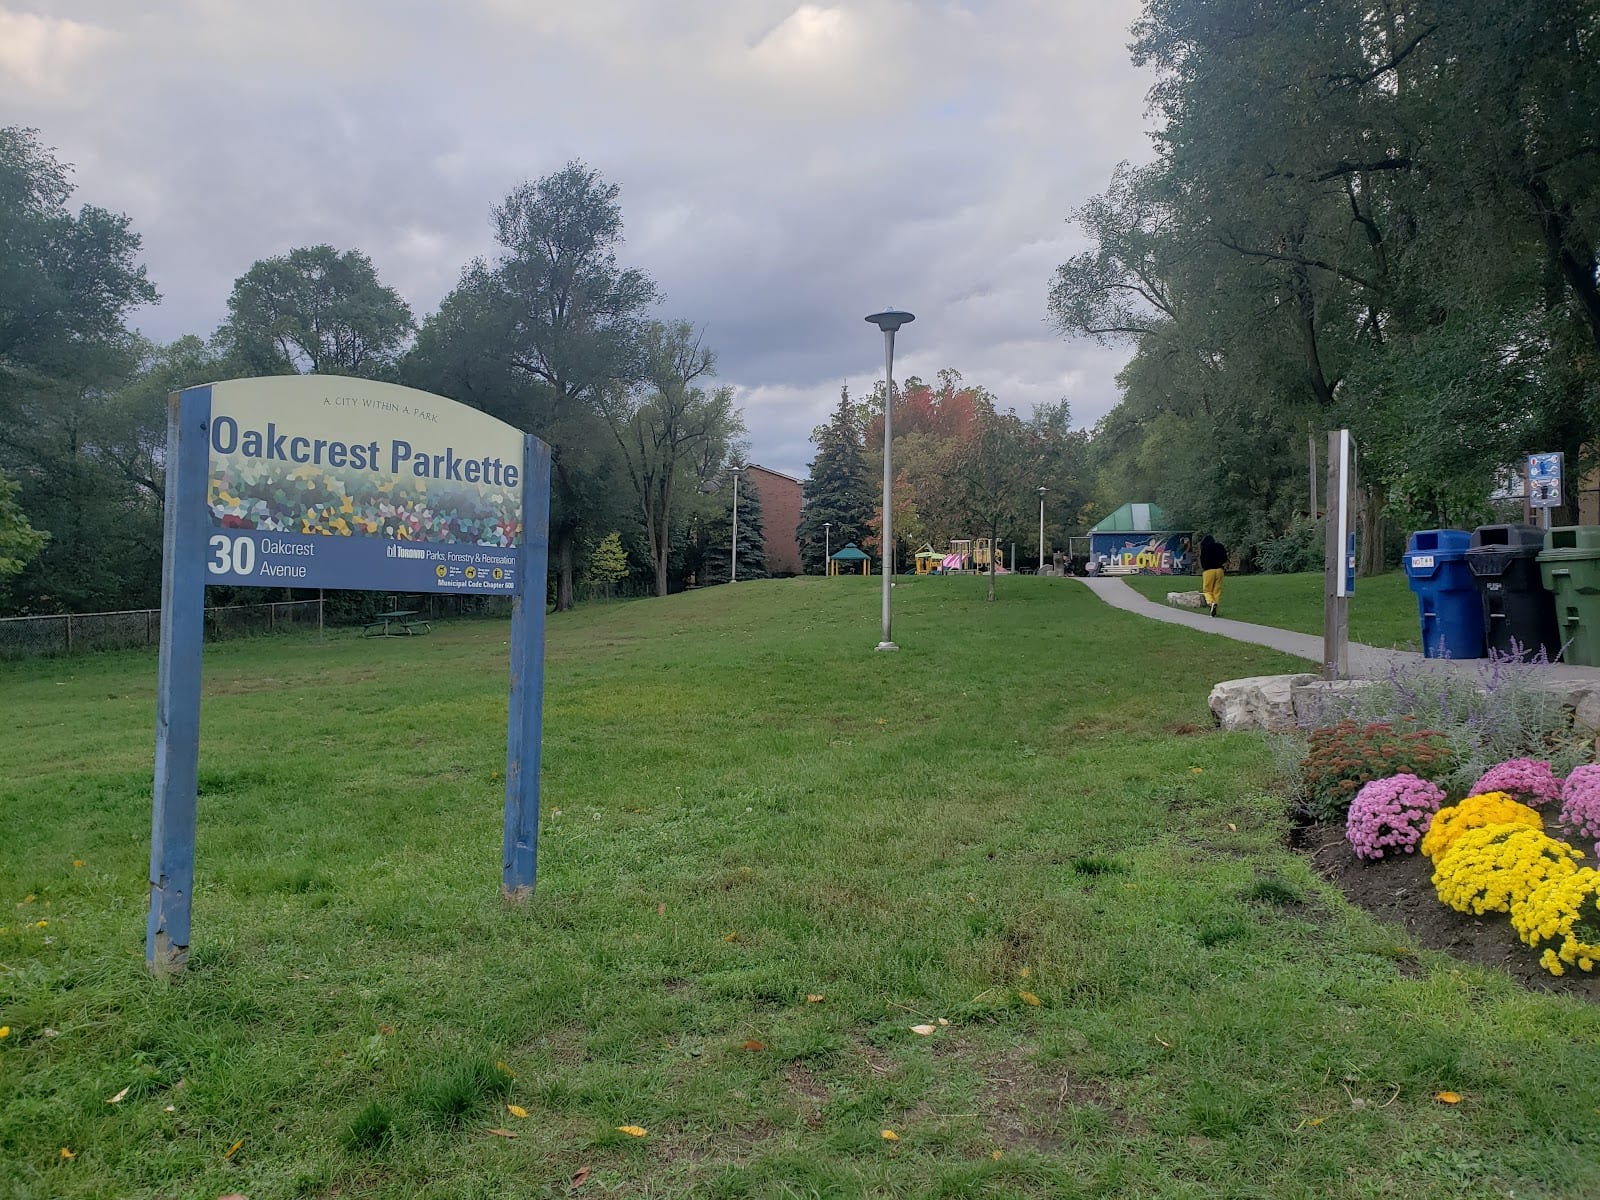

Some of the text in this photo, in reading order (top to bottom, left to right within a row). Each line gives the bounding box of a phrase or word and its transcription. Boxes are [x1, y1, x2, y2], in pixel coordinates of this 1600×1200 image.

[323, 397, 438, 424] A CITY WITHIN A PARK
[212, 416, 519, 488] Oakcrest Parkette
[207, 534, 256, 576] 30
[261, 538, 315, 556] Oakcrest
[426, 550, 447, 562] Parks,
[447, 551, 475, 564] Forestry
[475, 552, 481, 563] &
[481, 553, 516, 565] Recreation
[260, 561, 306, 578] Avenue
[437, 579, 467, 588] Municipal
[468, 580, 482, 588] Code
[483, 581, 504, 590] Chapter
